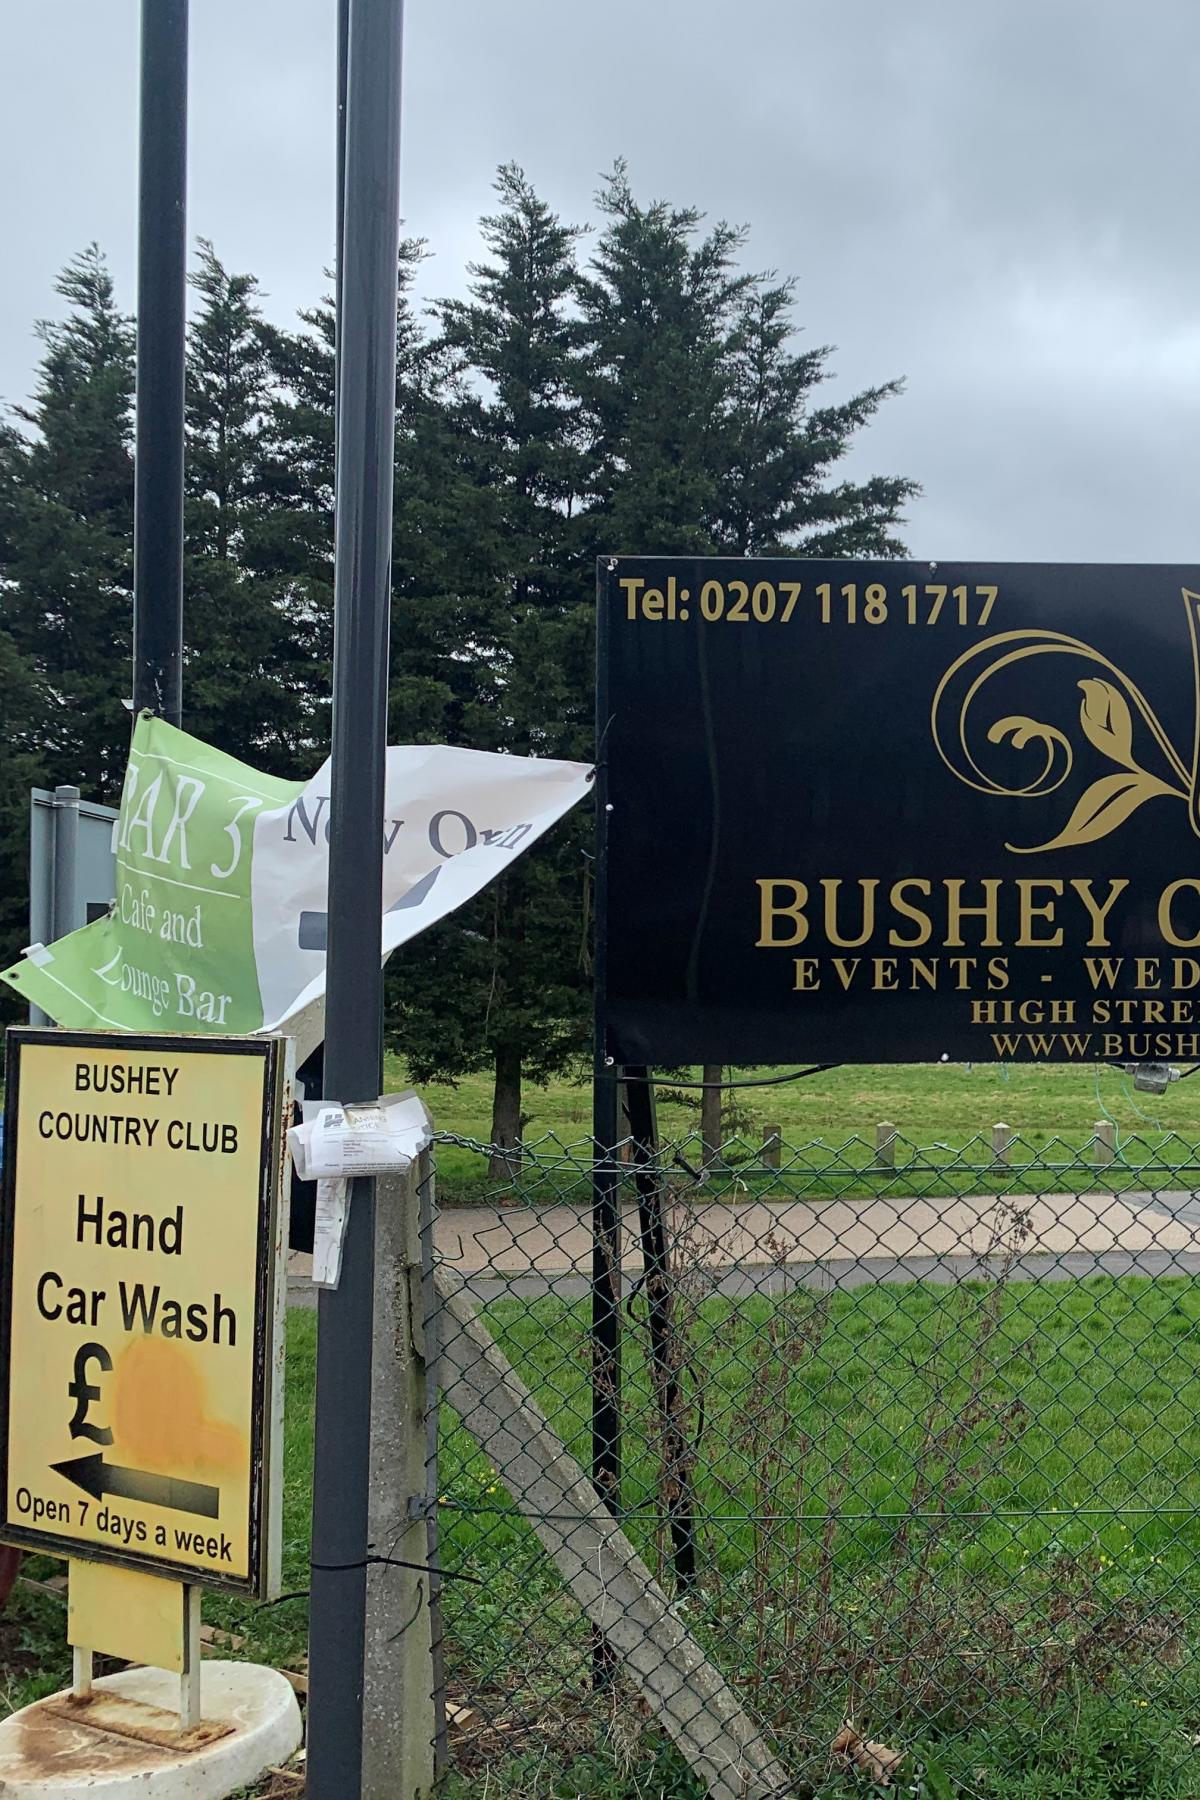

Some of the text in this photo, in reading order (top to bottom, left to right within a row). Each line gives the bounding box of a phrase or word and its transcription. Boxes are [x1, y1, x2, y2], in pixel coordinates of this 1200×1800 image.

[619, 576, 999, 626] Tel: 0207 118 1717
[210, 796, 264, 879] 3
[283, 796, 404, 855] Nw
[120, 883, 204, 949] Cafe and
[755, 878, 1130, 948] BUSHEY
[90, 945, 233, 1026] Lounge Bar
[792, 957, 1010, 990] EVENTS
[970, 1000, 1076, 1024] HIGH
[75, 1063, 179, 1096] BUSHEY
[38, 1110, 238, 1154] COUNTRY CLUB
[76, 1194, 184, 1256] Hand
[37, 1271, 236, 1347] Car Wash
[16, 1487, 233, 1562] Open 7 days a week
